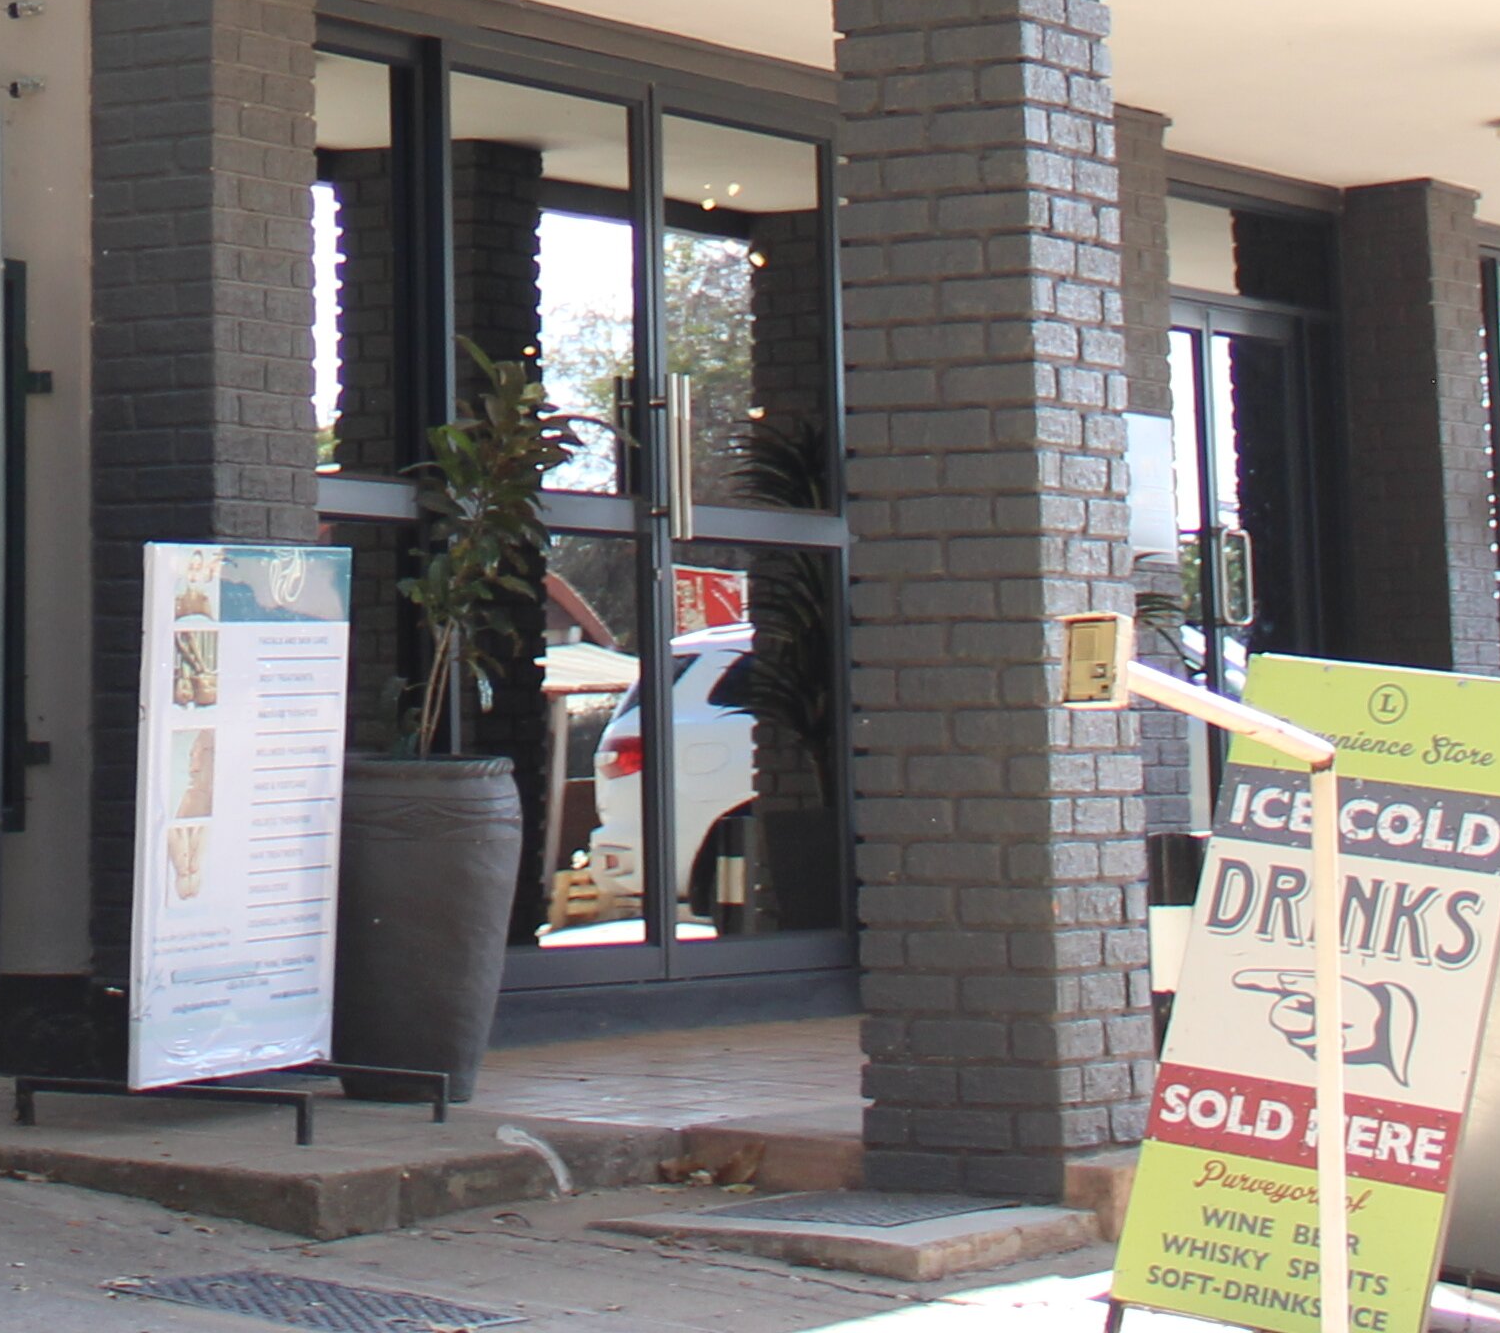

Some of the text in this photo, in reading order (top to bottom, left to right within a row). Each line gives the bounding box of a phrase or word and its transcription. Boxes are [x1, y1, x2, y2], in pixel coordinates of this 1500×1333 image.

[1296, 721, 1497, 768] enience Store
[1204, 857, 1486, 972] DRNKS
[1159, 1084, 1294, 1141] SOLD
[1194, 1159, 1319, 1204] Purveyor
[1202, 1206, 1360, 1256] WINE BER
[1147, 1265, 1321, 1319] SOFT-DRINKS
[1162, 1233, 1389, 1297] WHISKY SPITS
